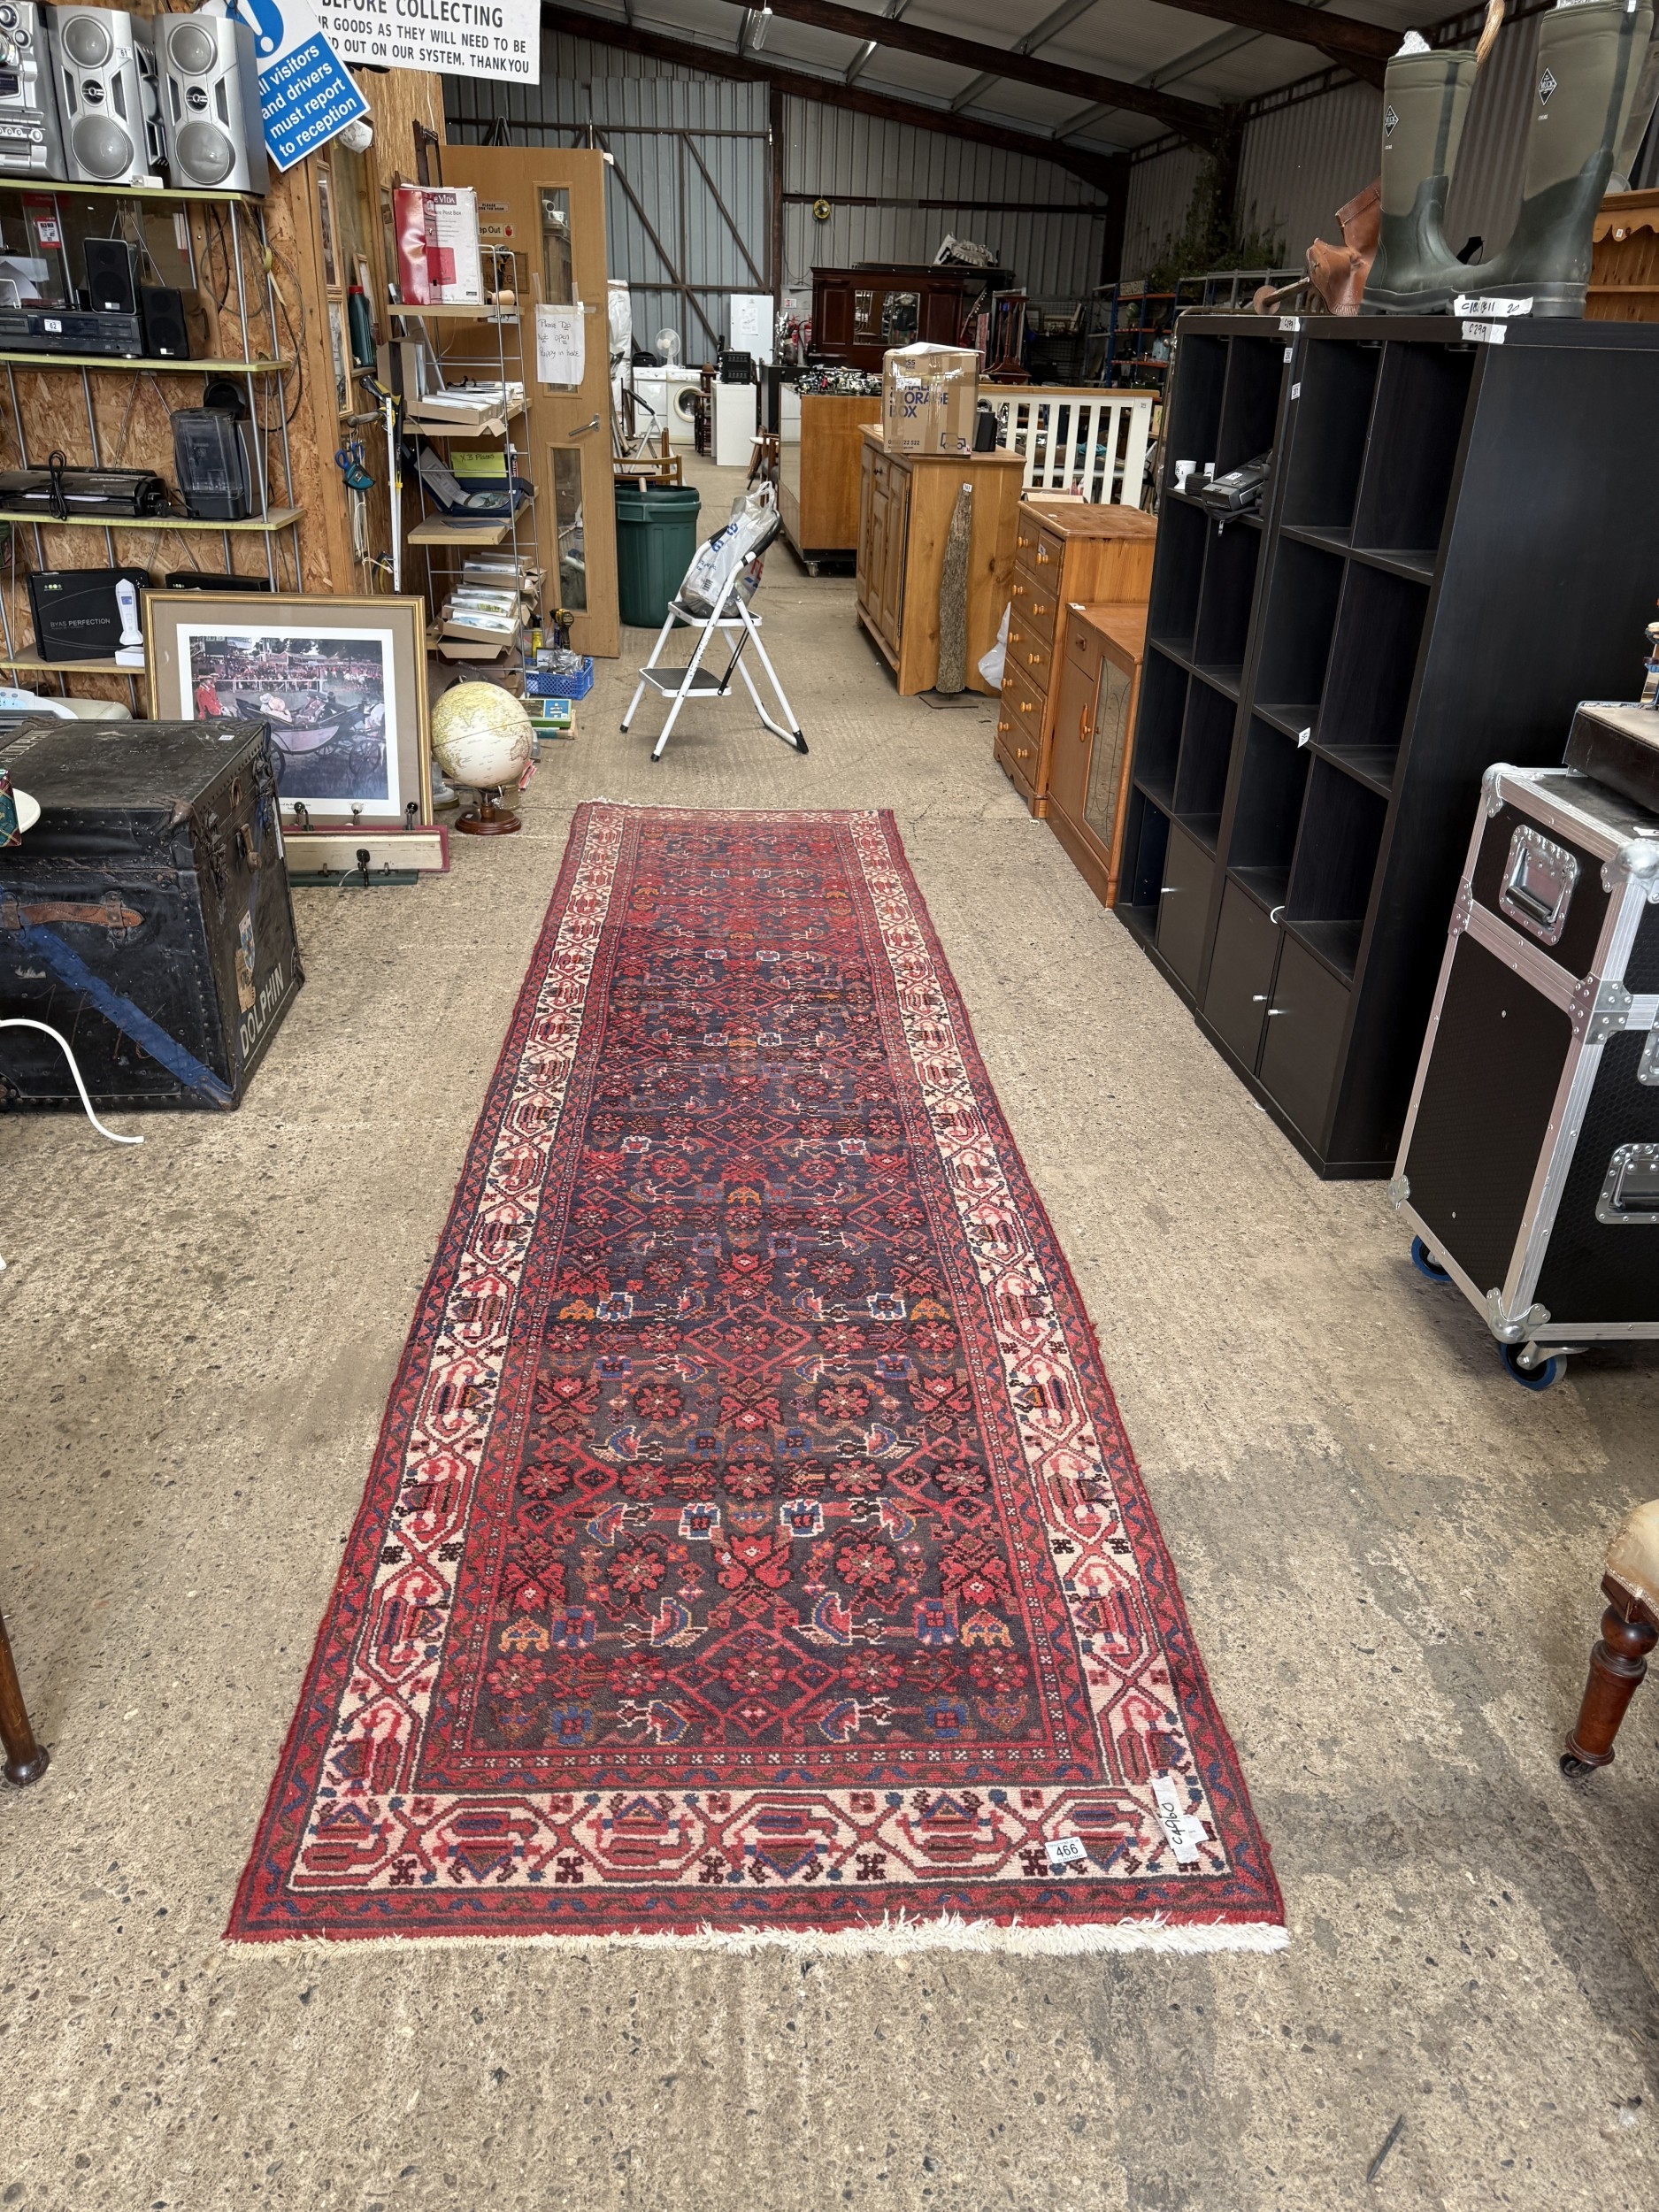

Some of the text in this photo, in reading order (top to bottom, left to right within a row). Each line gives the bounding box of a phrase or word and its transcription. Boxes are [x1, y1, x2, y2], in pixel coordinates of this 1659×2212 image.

[396, 0, 503, 27] COLLECTING
[334, 17, 373, 35] GOODS
[378, 23, 392, 37] AS
[397, 25, 425, 42] THEY
[431, 29, 457, 45] WILL
[462, 33, 489, 49] NEED
[494, 37, 508, 51] TO
[514, 40, 526, 53] BE
[344, 38, 367, 54] OUT
[372, 42, 387, 57] ON
[392, 45, 414, 59] OUR
[419, 48, 465, 66] SYSTEM.
[270, 45, 319, 85] visitors
[261, 62, 333, 119] and drivers
[270, 77, 346, 139] must report
[279, 97, 357, 157] to reception
[68, 618, 111, 626] PERFECTION
[240, 963, 284, 1059] DOLPHIN
[1056, 1843, 1079, 1857] 466
